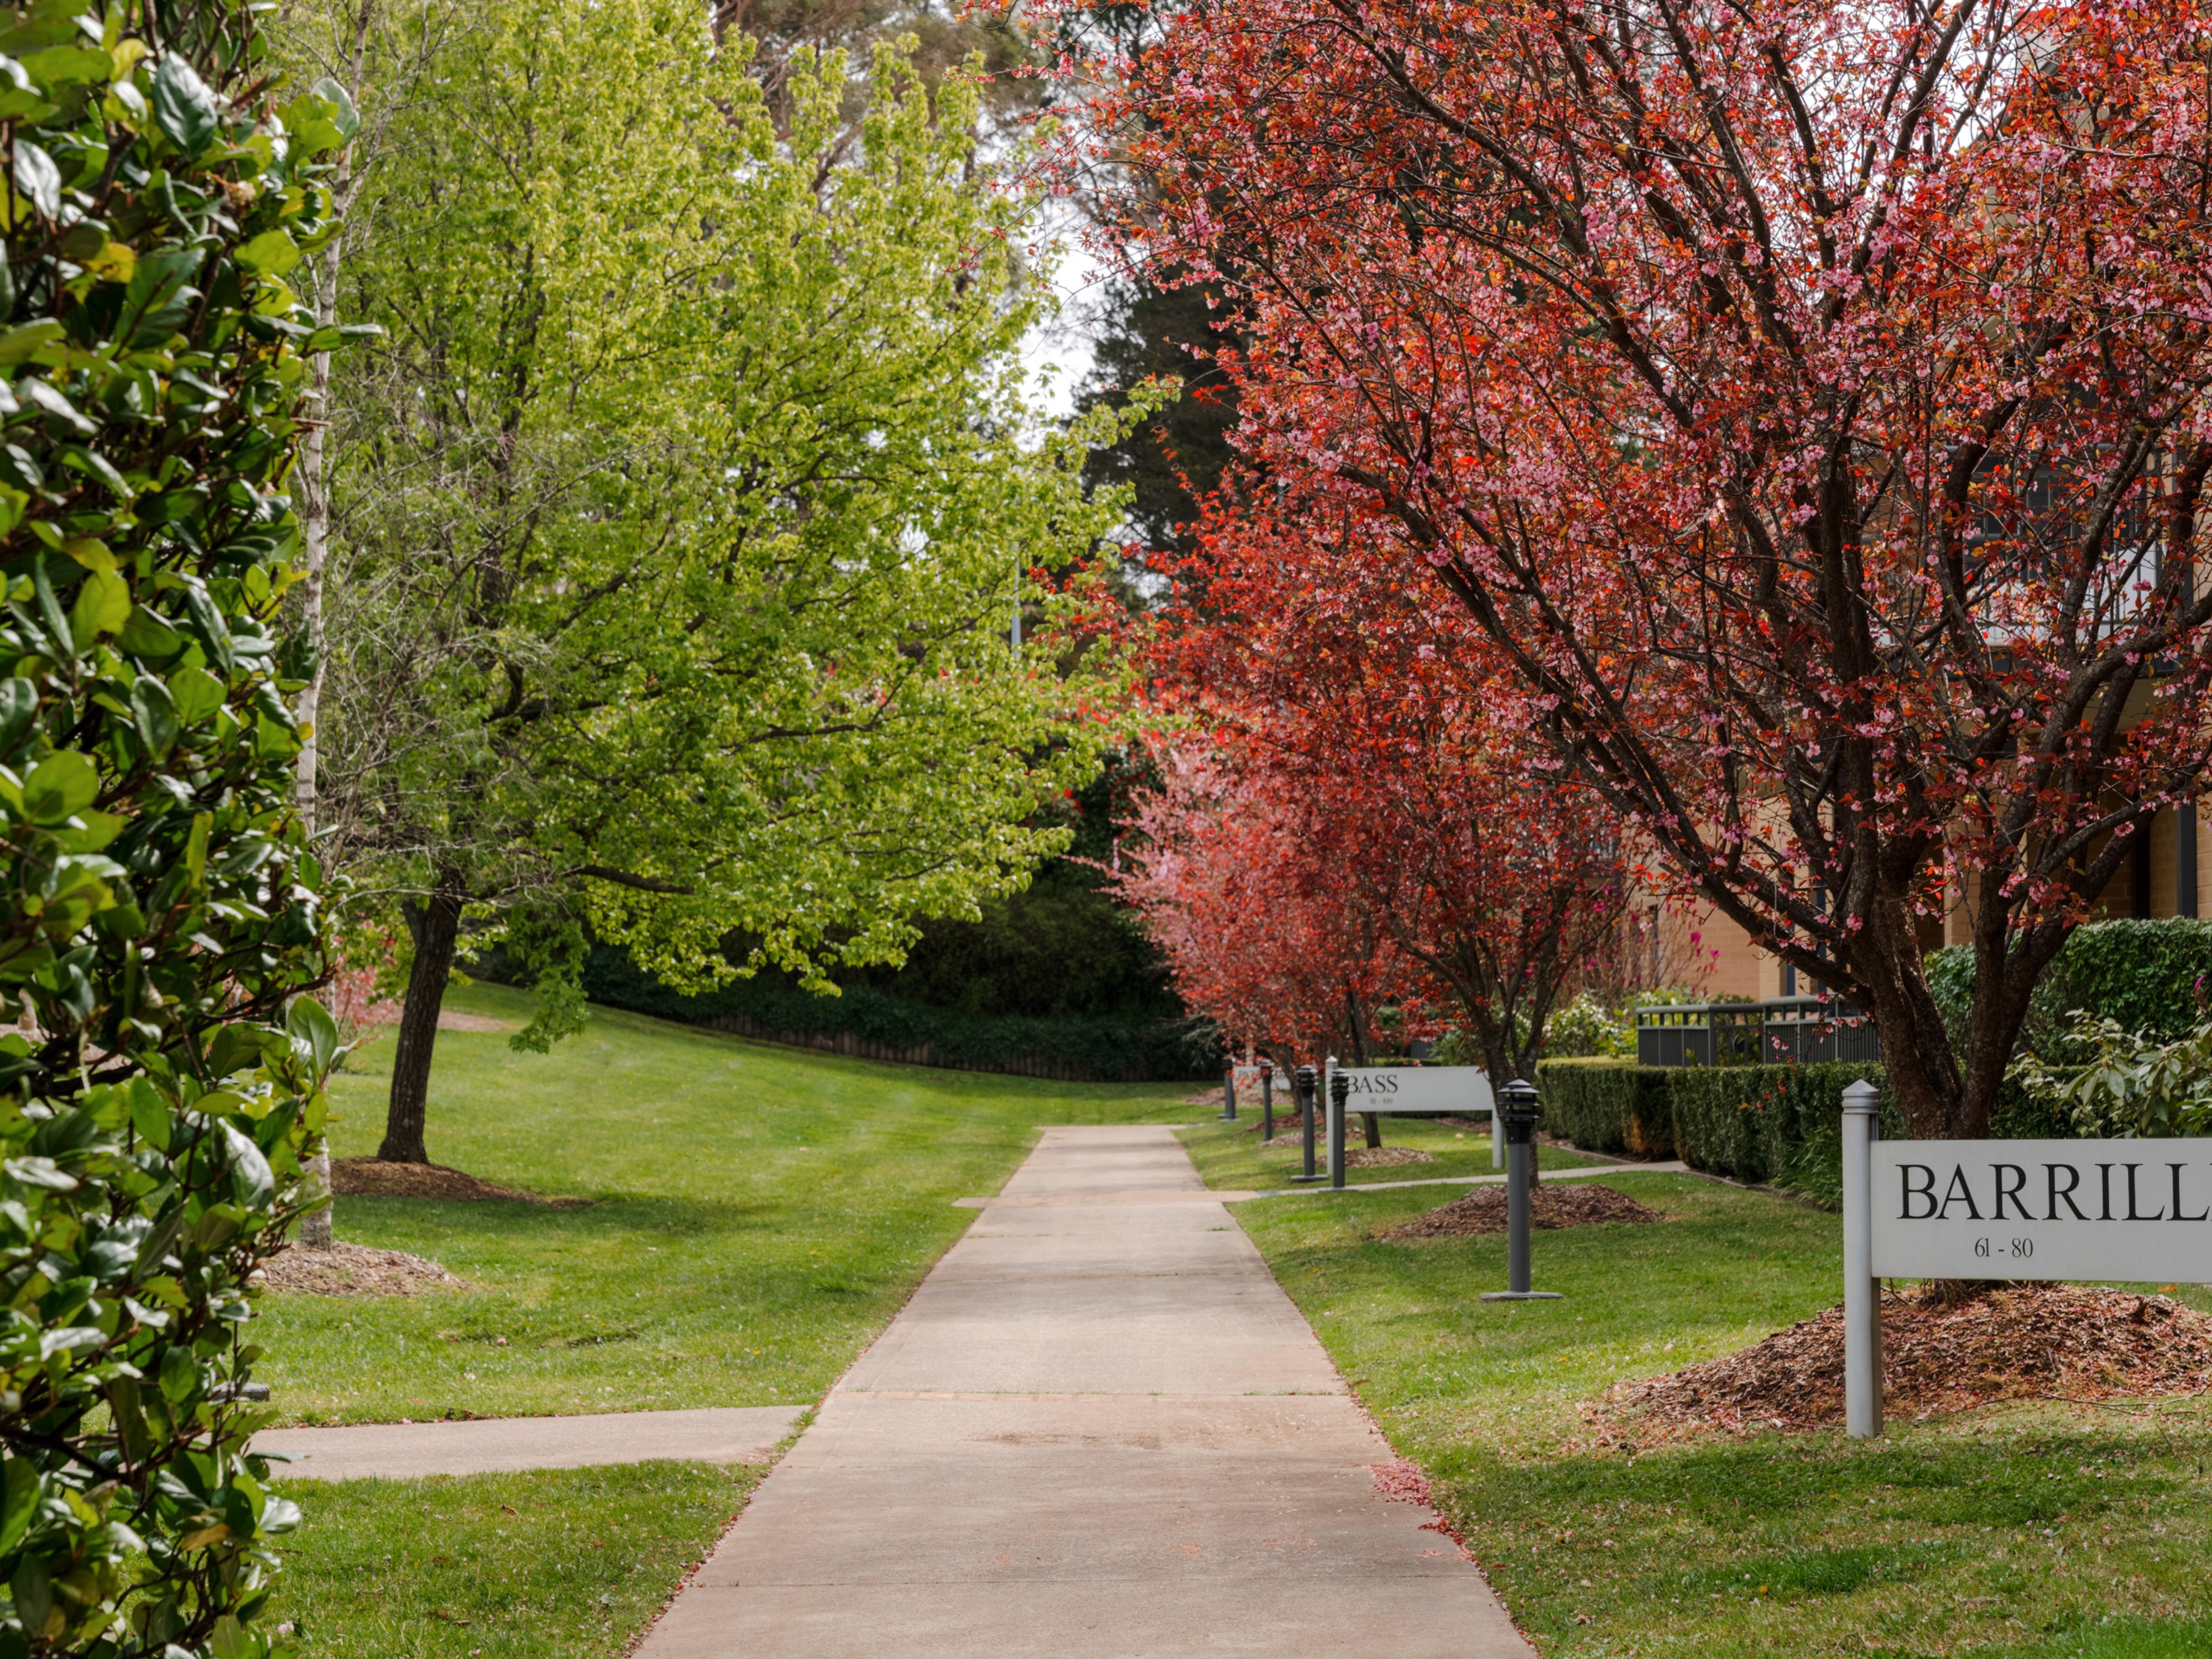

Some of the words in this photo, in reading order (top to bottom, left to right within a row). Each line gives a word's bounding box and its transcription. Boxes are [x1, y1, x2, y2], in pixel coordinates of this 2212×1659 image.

[1348, 1074, 1399, 1094] BASS
[1895, 1163, 2212, 1222] BARRILL
[1974, 1237, 1990, 1258] 61
[2011, 1237, 2034, 1258] 80
